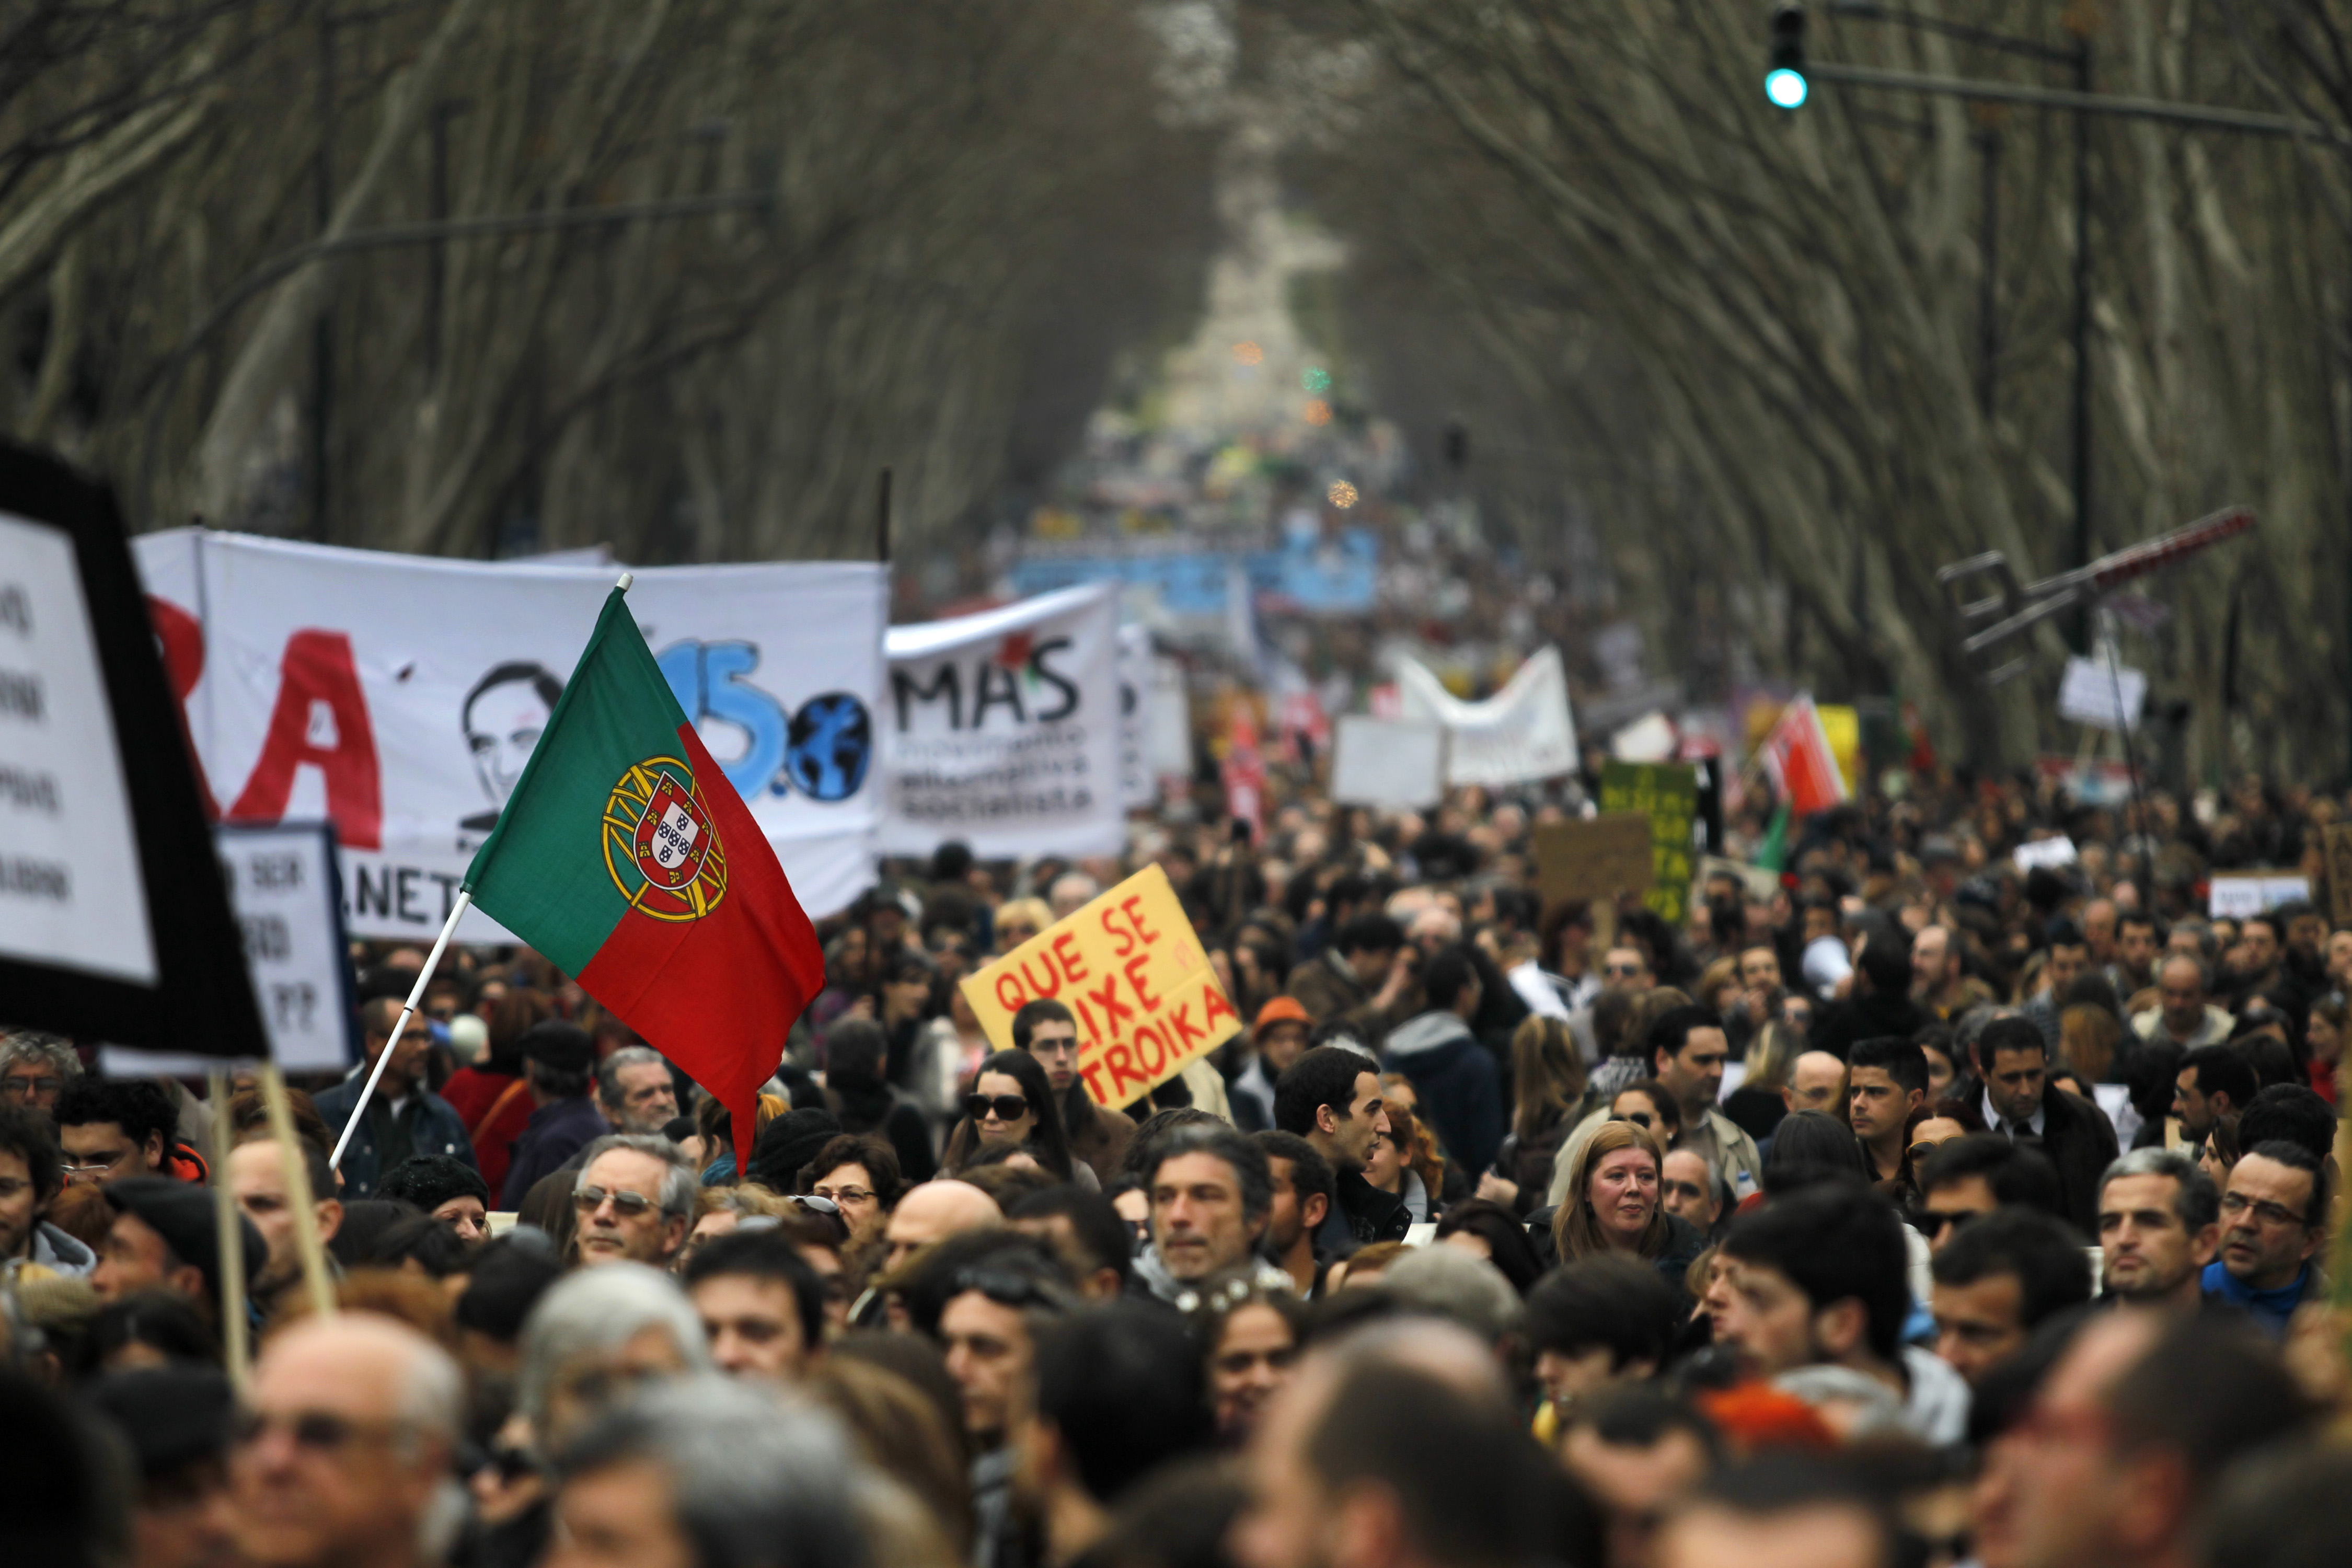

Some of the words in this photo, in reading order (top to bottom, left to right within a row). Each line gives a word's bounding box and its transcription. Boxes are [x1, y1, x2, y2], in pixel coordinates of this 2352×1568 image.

[891, 635, 1080, 732] MAS
[995, 931, 1089, 1013] QUE
[1101, 894, 1160, 956] SE
[1076, 953, 1163, 1056] IXE
[1079, 984, 1238, 1105] TROIKA
